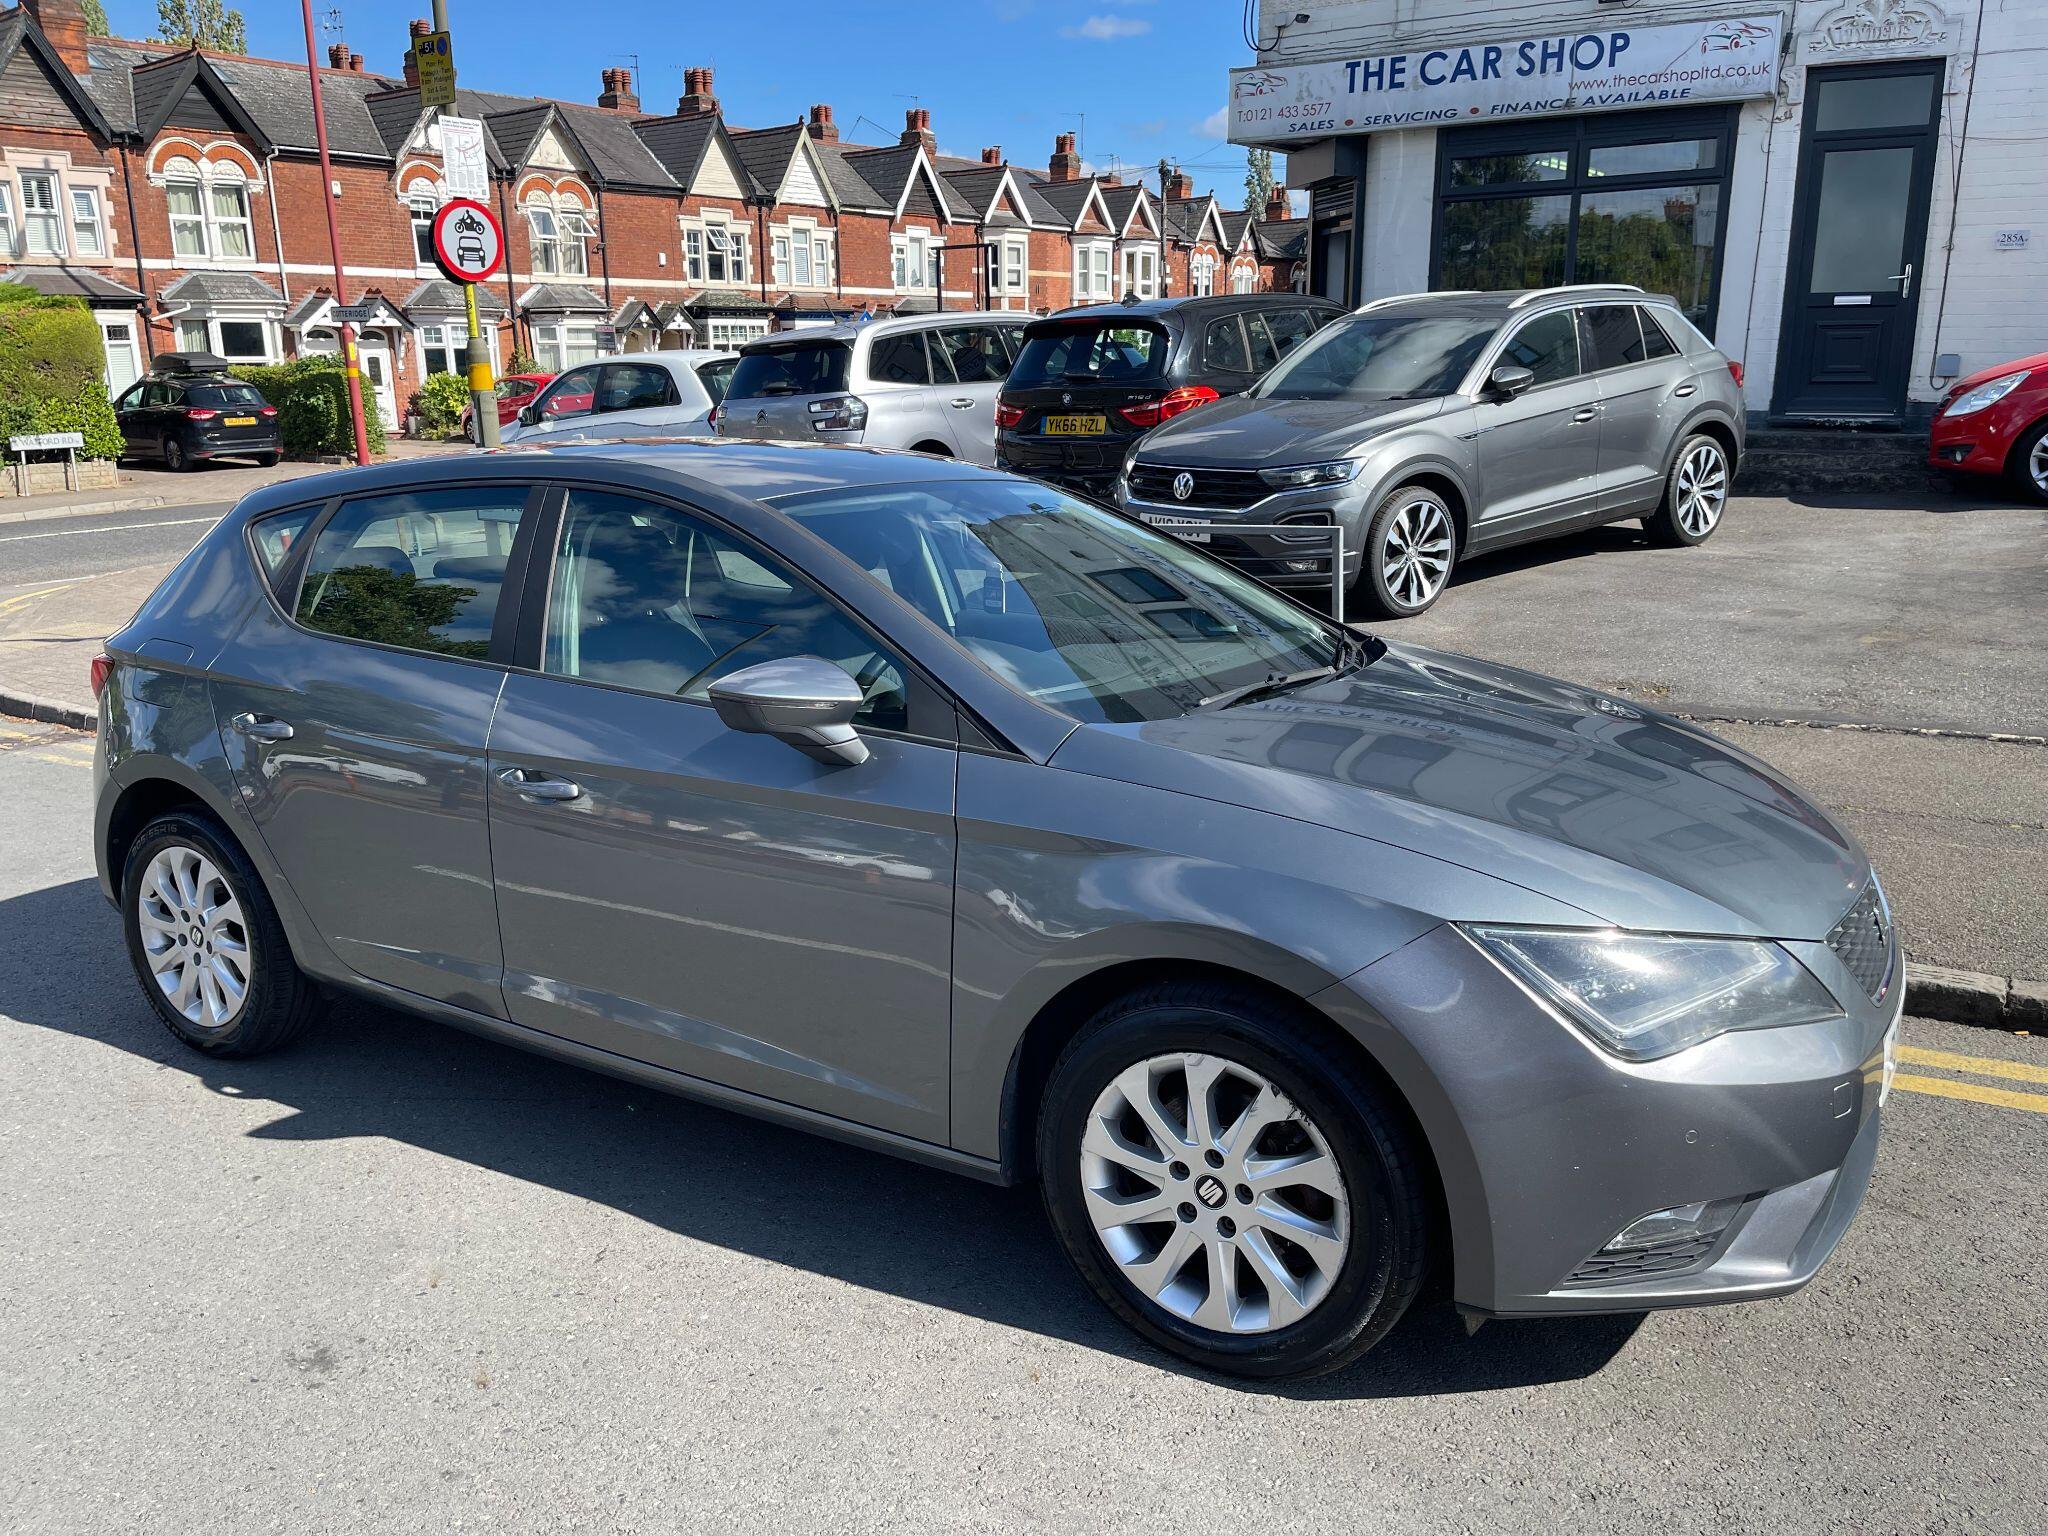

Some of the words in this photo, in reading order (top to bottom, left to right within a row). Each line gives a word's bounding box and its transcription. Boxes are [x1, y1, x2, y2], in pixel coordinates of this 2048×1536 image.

[1346, 56, 1406, 93] THE
[1420, 46, 1501, 85] CAR
[1516, 33, 1630, 76] SHOP
[1568, 61, 1771, 91] www.thecarshopltd.co.uk
[1237, 108, 1272, 122] T:0121
[1278, 105, 1299, 119] 433
[1302, 103, 1332, 116] 5577
[1288, 120, 1335, 132] SALES
[1363, 108, 1458, 126] SERVICING
[1490, 97, 1577, 114] FINANCE
[1582, 88, 1691, 106] AVAILABLE
[2000, 233, 2024, 243] 285A
[333, 310, 367, 318] COTTERIDGE
[1048, 418, 1077, 432] YK66
[1081, 418, 1102, 432] HZL
[62, 436, 73, 444] RD
